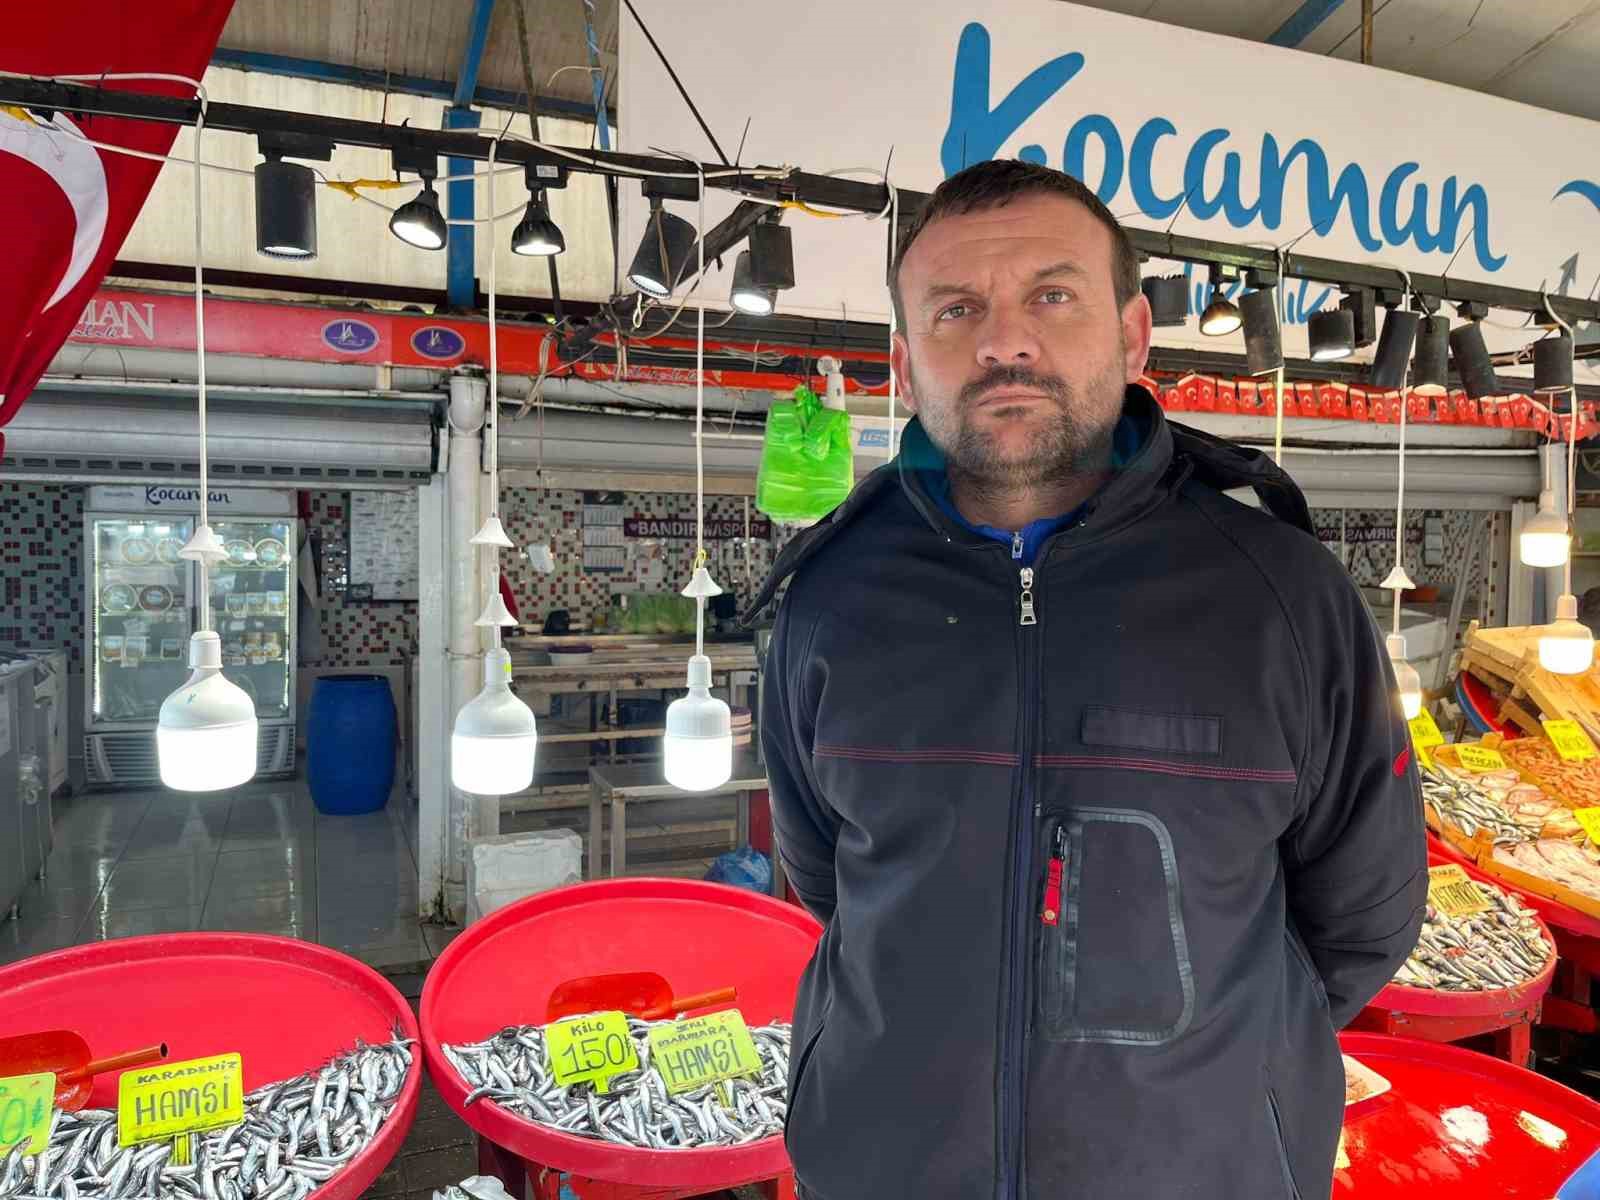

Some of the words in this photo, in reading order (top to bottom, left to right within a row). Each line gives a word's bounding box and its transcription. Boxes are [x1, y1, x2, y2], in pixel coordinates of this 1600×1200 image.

[941, 22, 1507, 271] Kocaman
[137, 1060, 238, 1083] KARADENİZ
[664, 1031, 741, 1083] HAMSİ
[135, 1076, 230, 1126] HAMSİ
